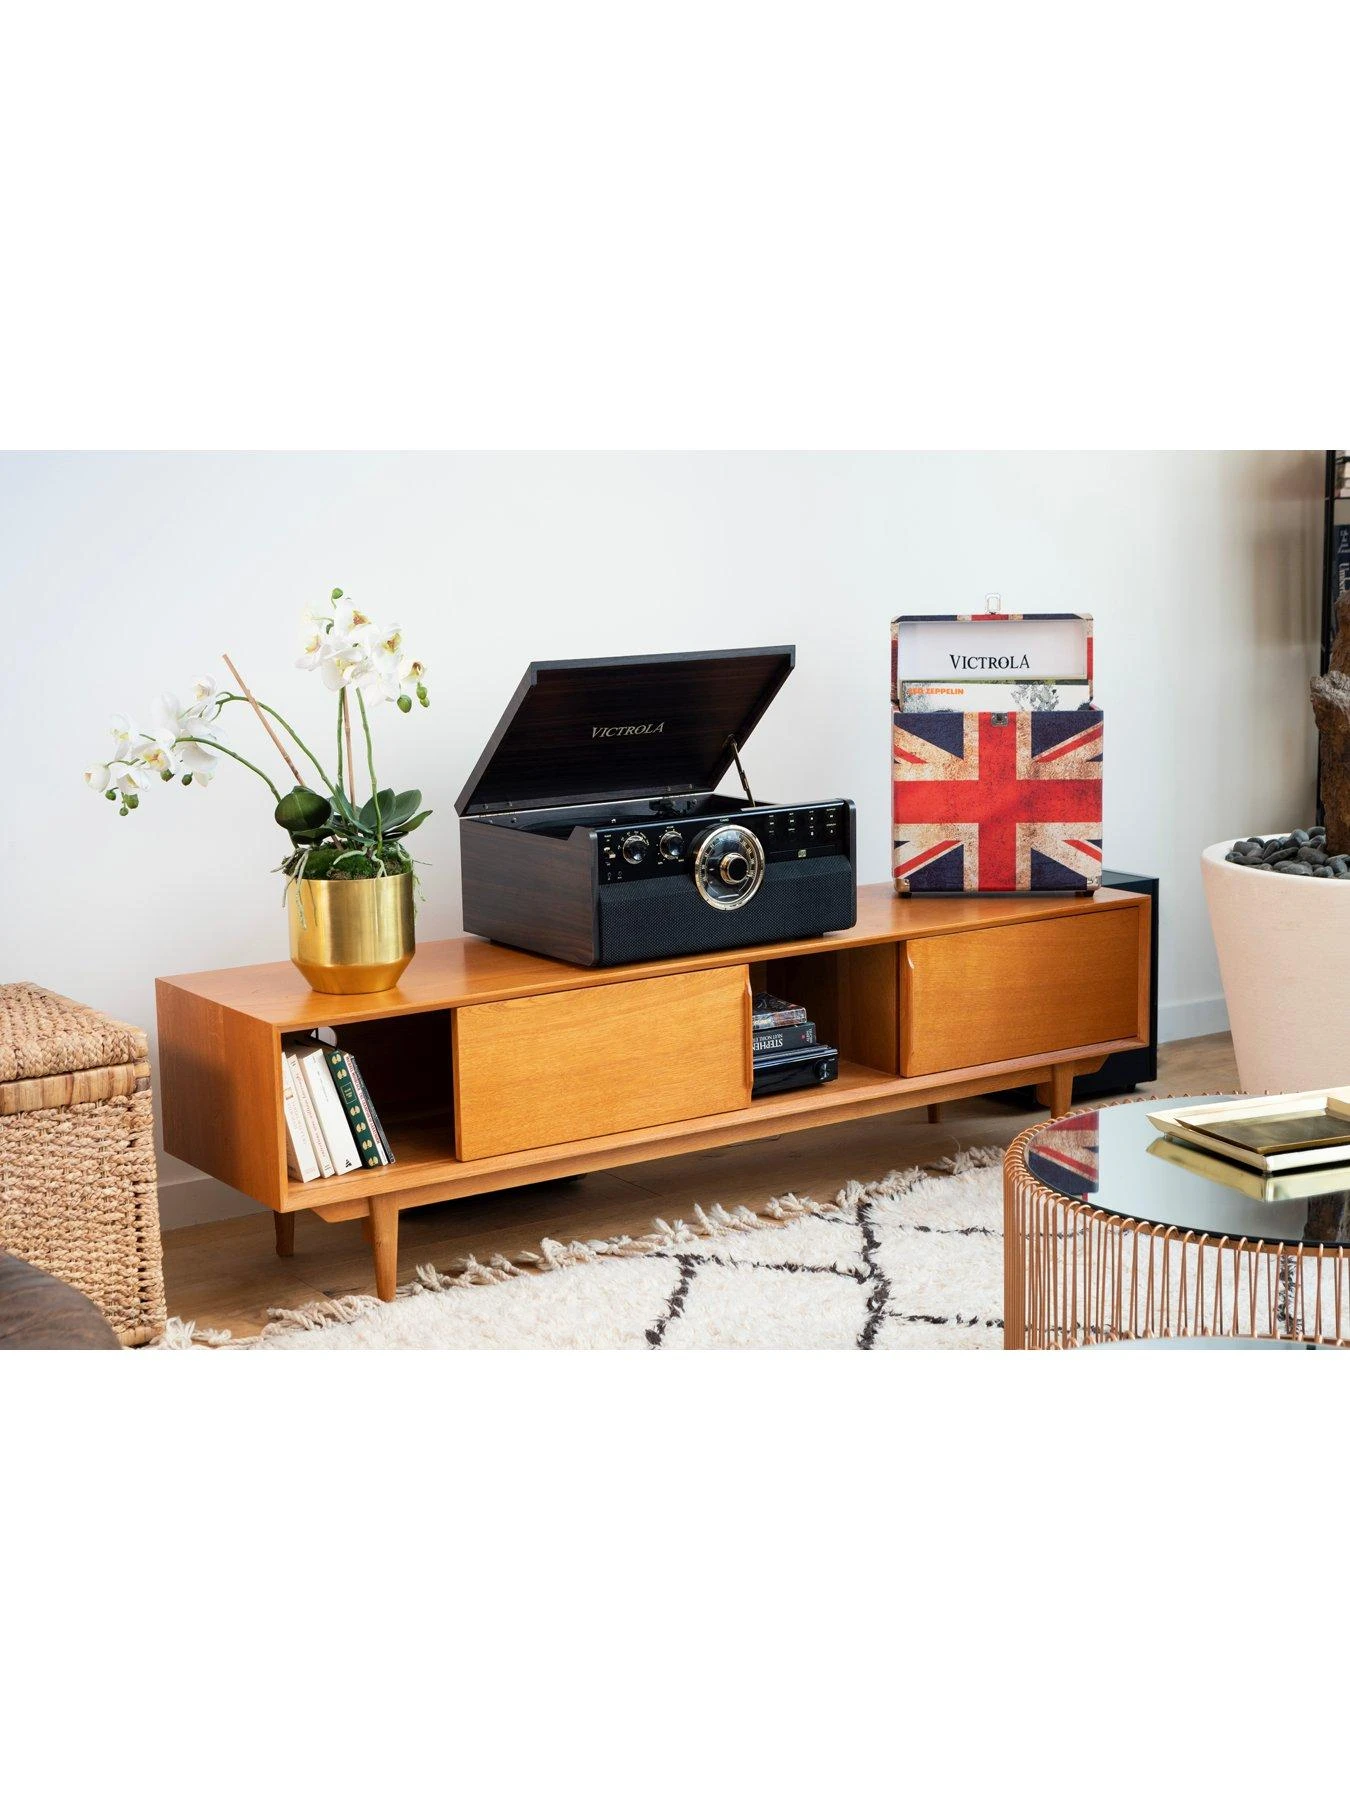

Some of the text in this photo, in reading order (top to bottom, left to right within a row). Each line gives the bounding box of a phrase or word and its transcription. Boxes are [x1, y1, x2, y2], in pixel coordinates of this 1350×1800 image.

[949, 654, 1030, 669] VICTROLA
[926, 687, 964, 695] ZEPPELIN
[592, 722, 665, 738] VICTROLA
